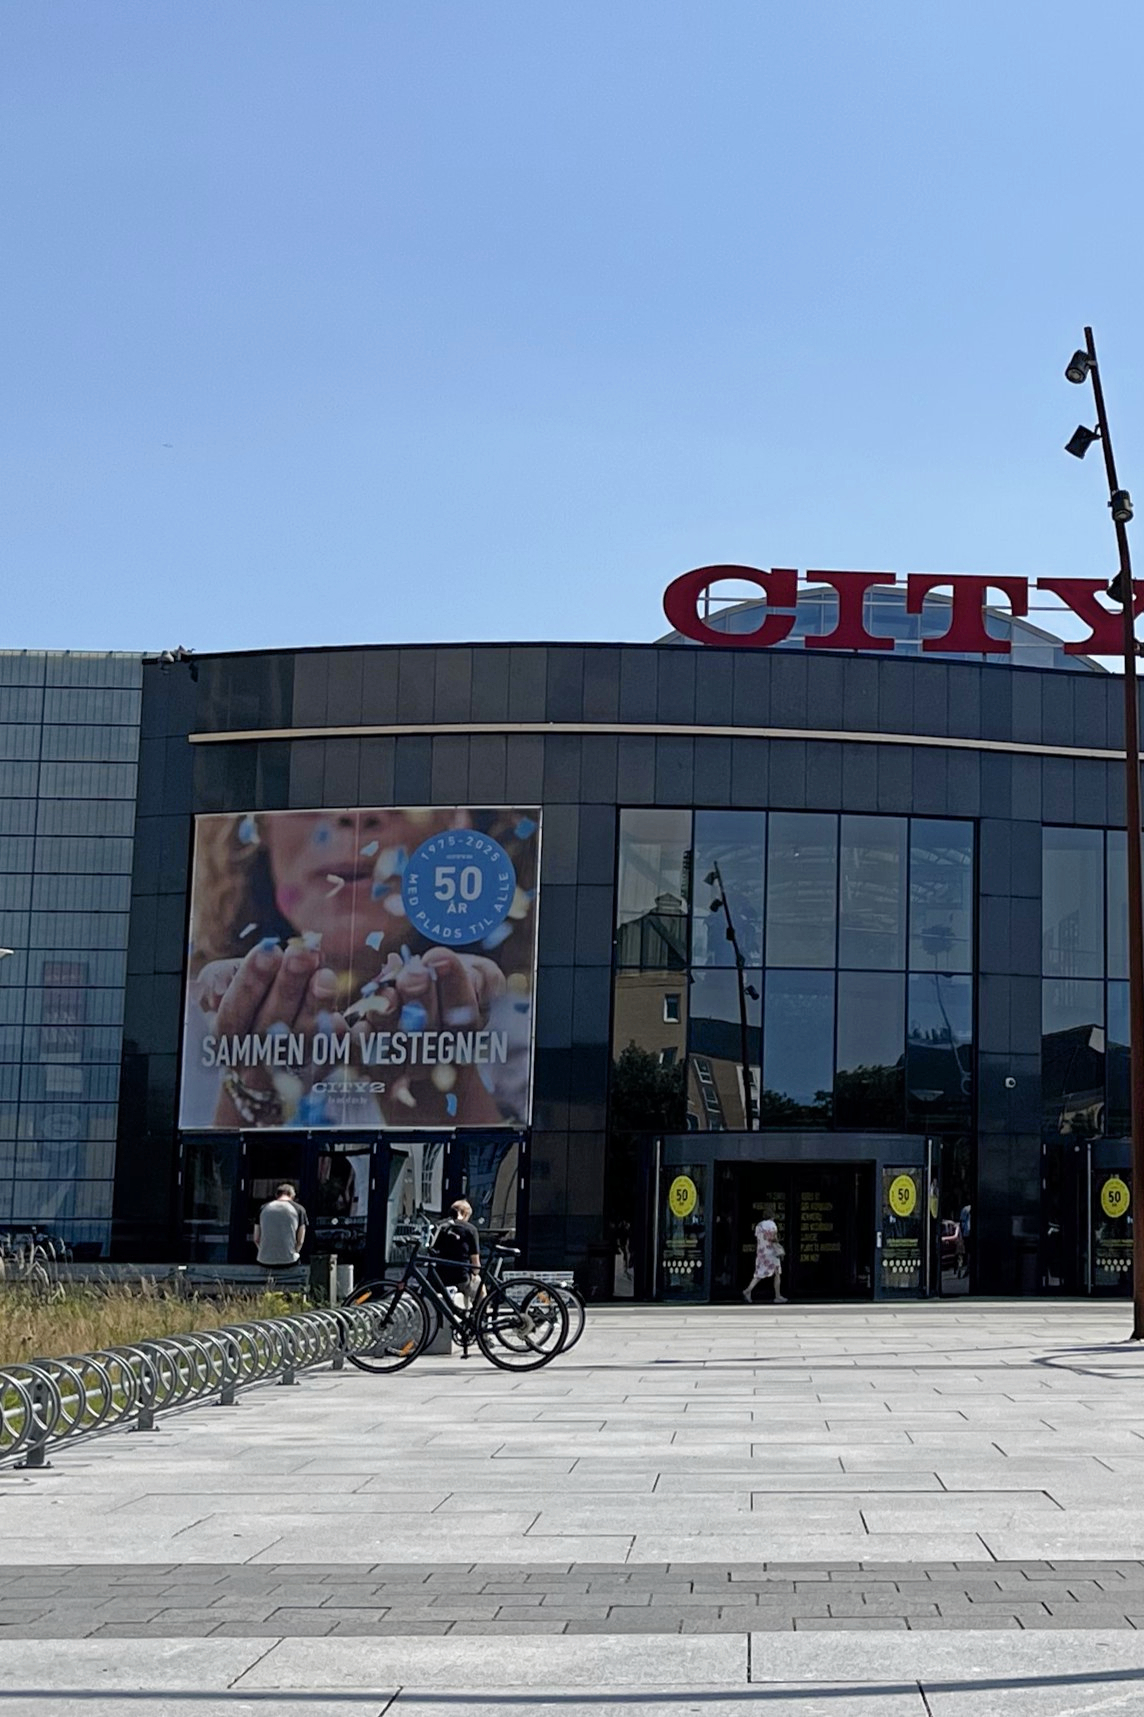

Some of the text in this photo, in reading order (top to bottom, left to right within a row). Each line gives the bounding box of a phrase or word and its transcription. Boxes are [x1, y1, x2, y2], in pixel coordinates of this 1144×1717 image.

[421, 836, 500, 862] 1975-2025
[434, 865, 483, 901] 50
[408, 872, 510, 938] MED PLADS TIL ALLE
[446, 900, 468, 914] ÅR
[202, 1031, 508, 1067] SAMMEN OM VESTEGNEN
[312, 1081, 386, 1094] CITY2
[676, 1189, 688, 1202] 50
[898, 1188, 910, 1201] 50
[1108, 1191, 1121, 1203] 50
